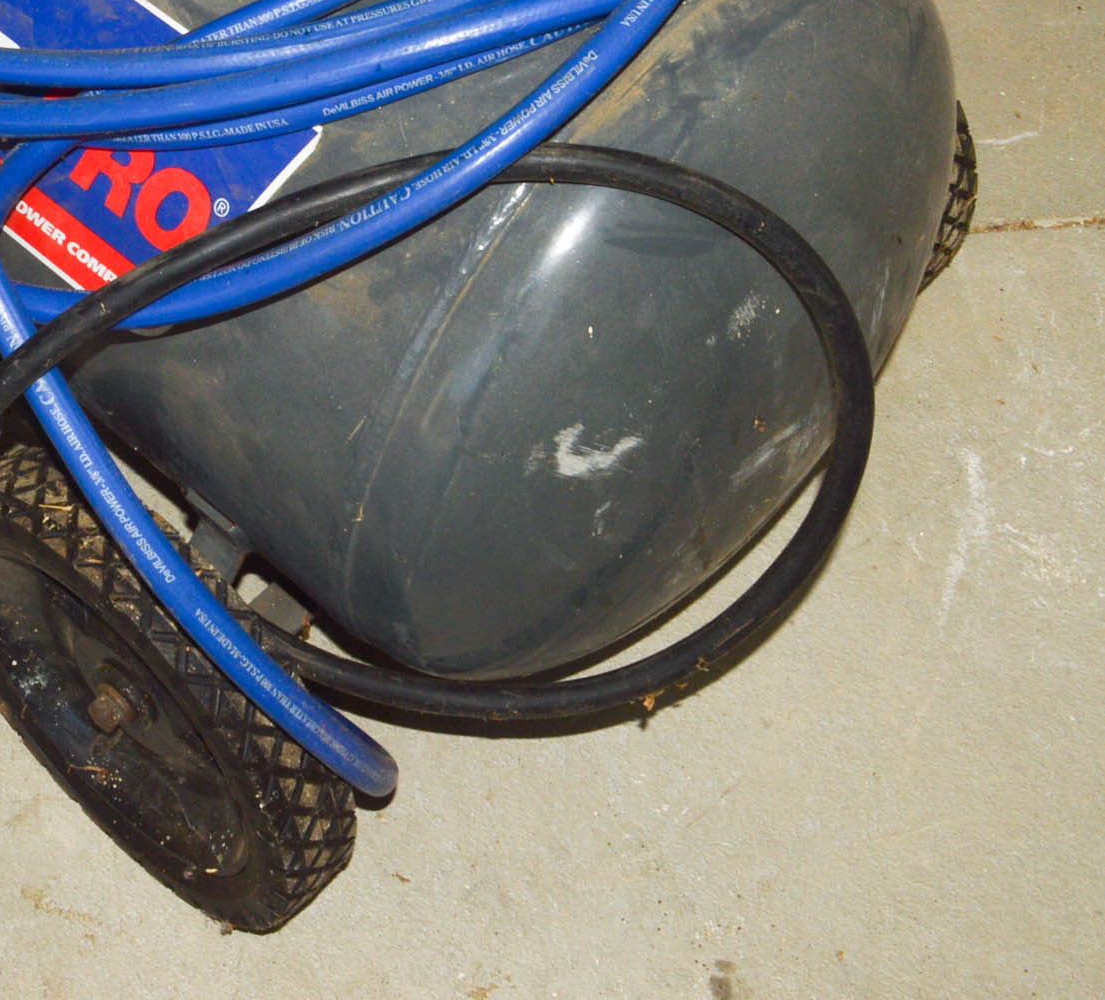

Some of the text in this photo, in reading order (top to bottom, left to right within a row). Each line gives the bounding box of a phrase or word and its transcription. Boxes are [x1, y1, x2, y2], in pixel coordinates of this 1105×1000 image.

[350, 0, 412, 24] PRESSURES
[619, 8, 642, 27] USA
[225, 18, 258, 36] THAN
[549, 47, 598, 96] DeVILBISS
[321, 92, 376, 117] DeVILBISS
[374, 87, 394, 101] AIR
[532, 87, 554, 109] AIR
[266, 119, 289, 129] USA
[63, 430, 84, 454] AIR
[122, 520, 142, 541] AIR
[134, 533, 176, 586] DeVILBISS
